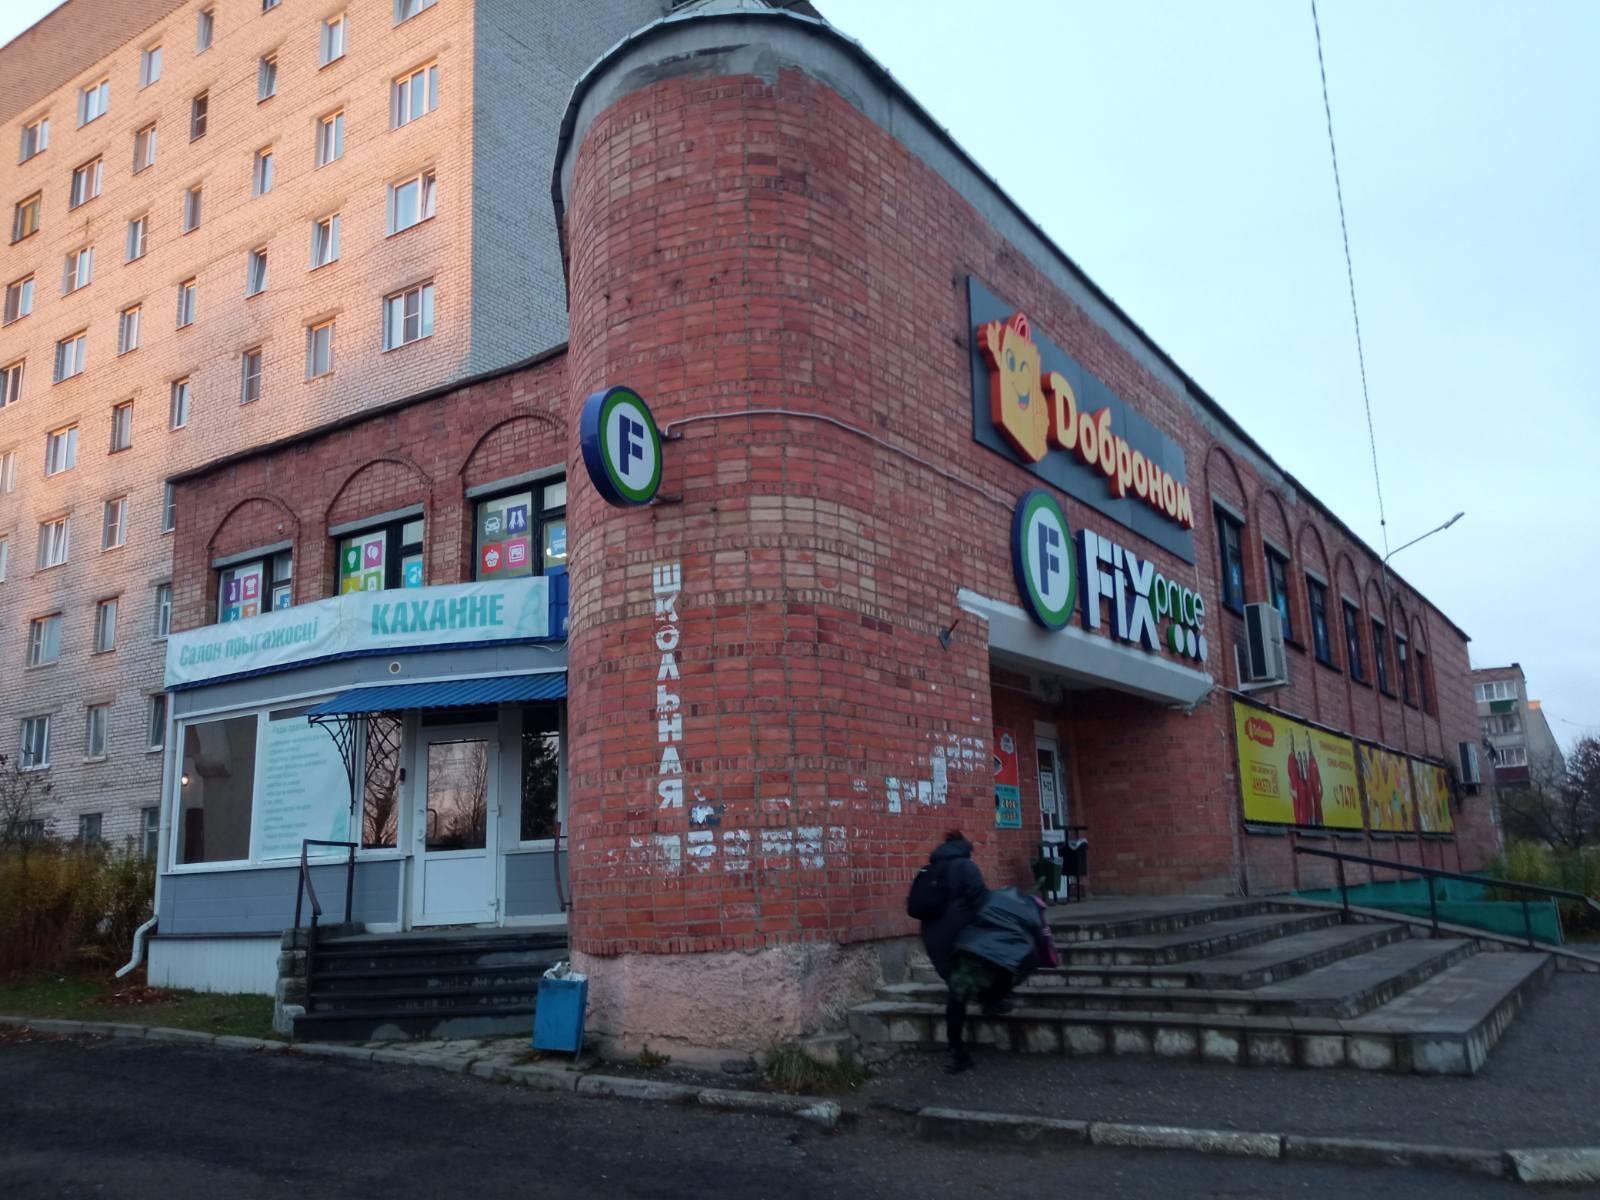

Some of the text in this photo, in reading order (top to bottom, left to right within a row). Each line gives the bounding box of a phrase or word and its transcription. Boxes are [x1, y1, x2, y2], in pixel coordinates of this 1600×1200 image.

[619, 413, 644, 476] F
[1047, 371, 1194, 529] Доброном
[1038, 521, 1060, 596] F
[372, 594, 504, 636] КАХАННЕ
[1154, 572, 1206, 630] price
[179, 616, 319, 667] Салон прыгажосці
[652, 564, 684, 809] ШКОЛЬНАЯ
